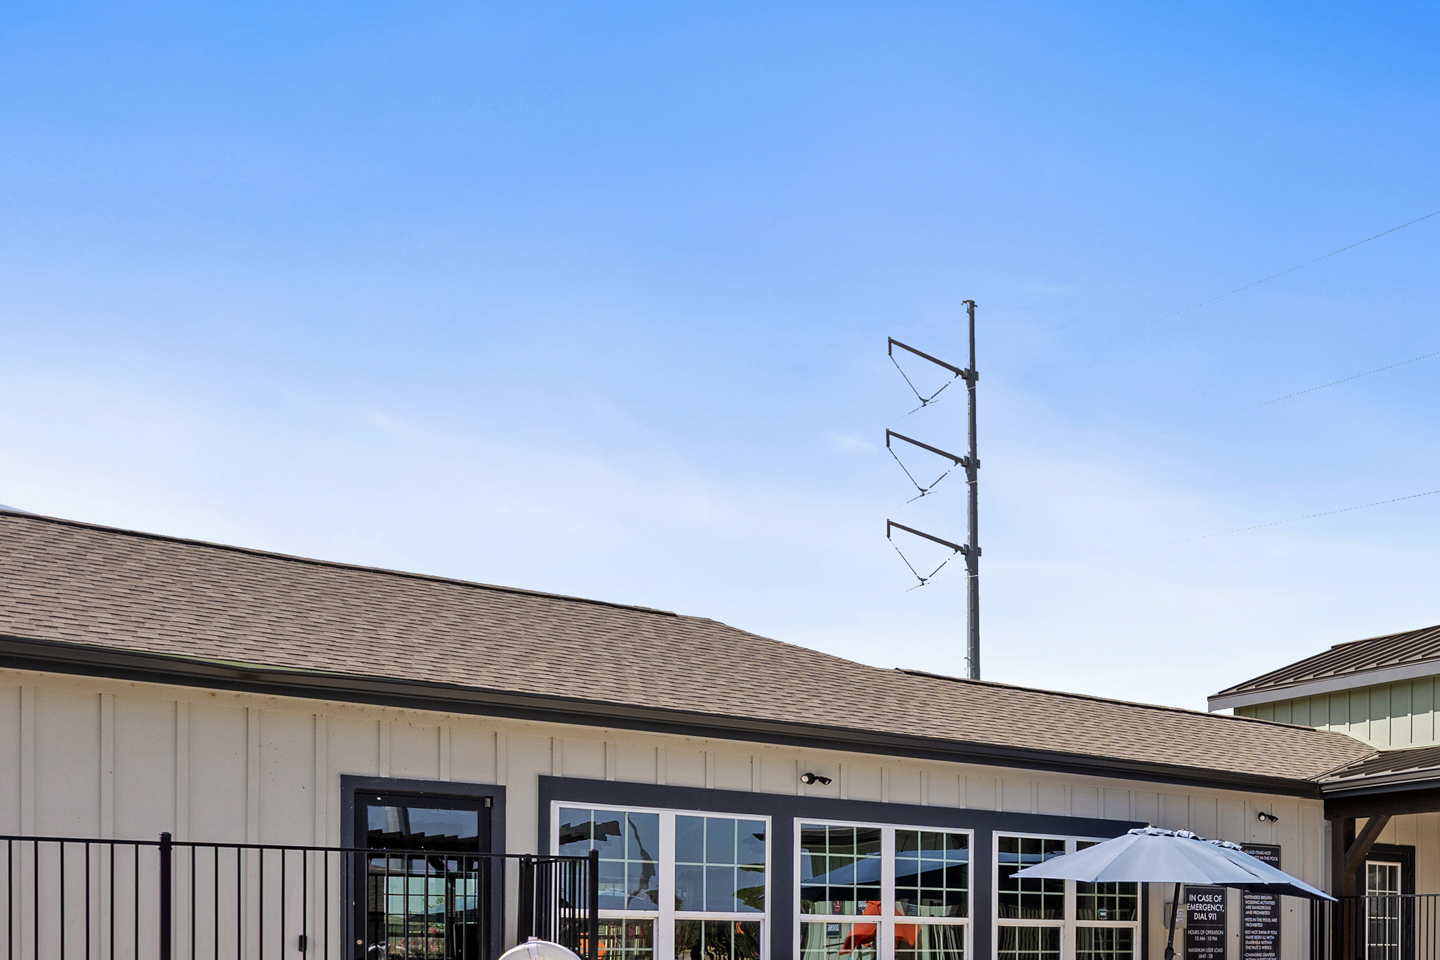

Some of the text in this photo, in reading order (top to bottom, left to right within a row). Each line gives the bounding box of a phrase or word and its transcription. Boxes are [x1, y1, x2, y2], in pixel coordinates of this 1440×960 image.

[1189, 894, 1223, 903] IN CASE OF
[1187, 903, 1225, 913] EMERGENCY,
[1194, 912, 1208, 920] DIAL
[1208, 912, 1217, 920] 911
